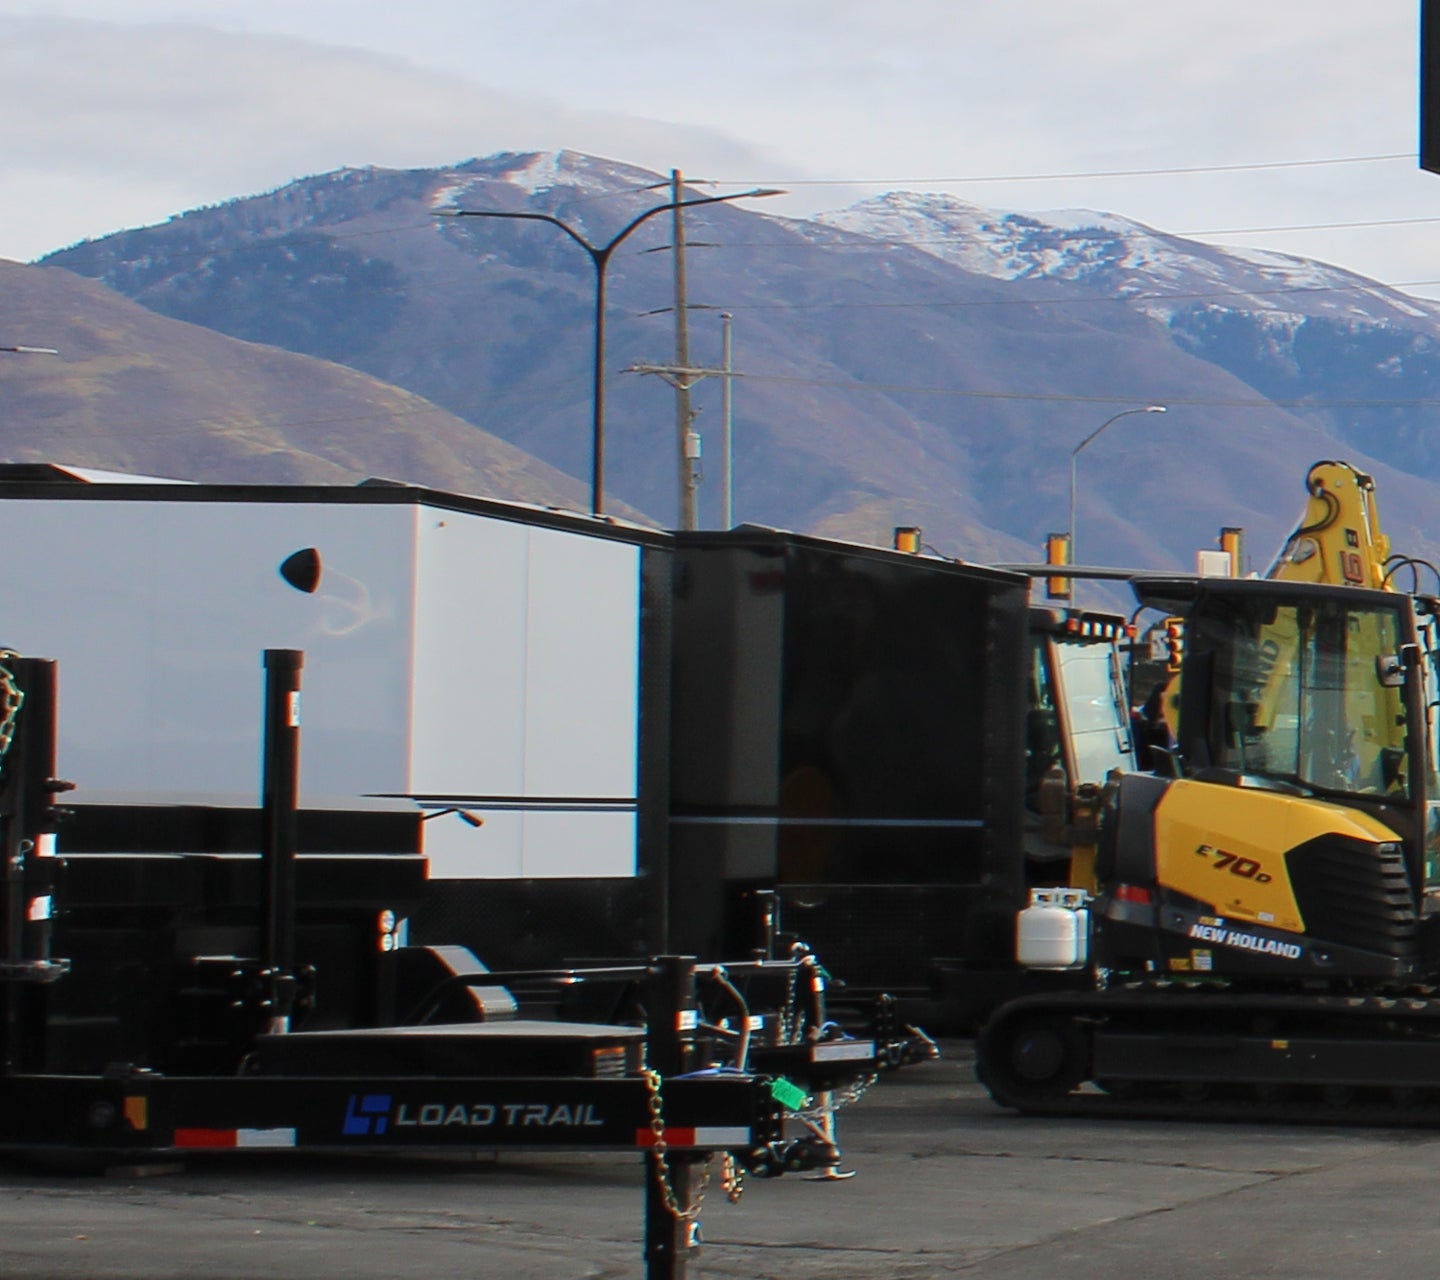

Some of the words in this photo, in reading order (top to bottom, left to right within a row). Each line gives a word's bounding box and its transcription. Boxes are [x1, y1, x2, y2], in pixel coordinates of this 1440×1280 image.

[1190, 923, 1228, 943] NEW
[1227, 931, 1302, 959] HOLLAND
[395, 1104, 496, 1126] LOAD
[502, 1104, 604, 1126] TRAIL
